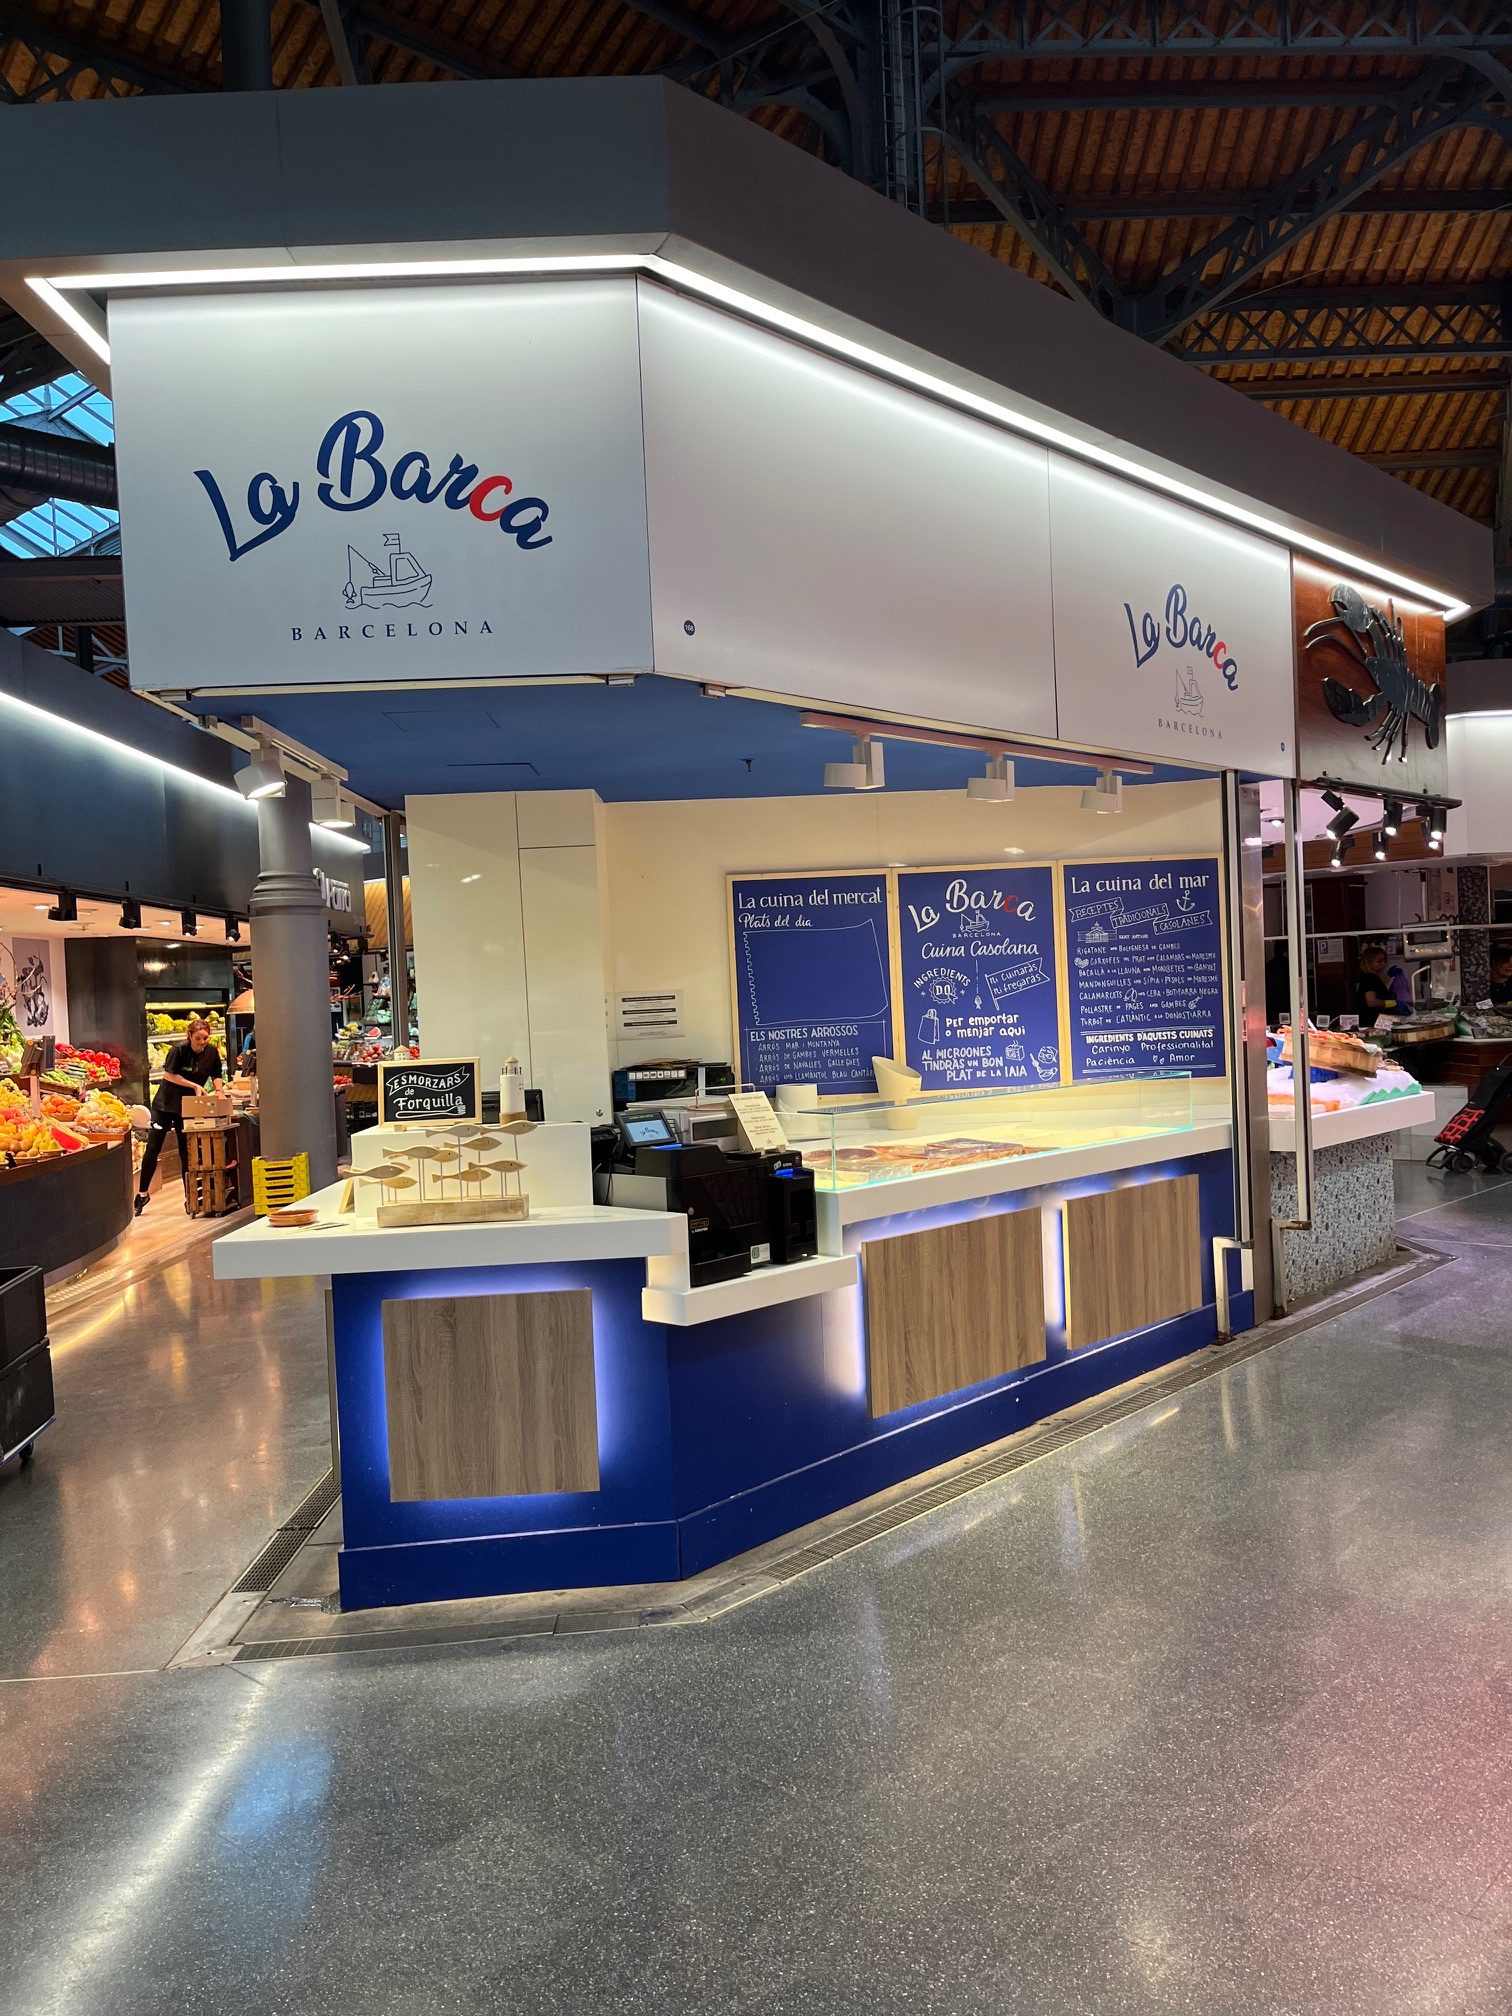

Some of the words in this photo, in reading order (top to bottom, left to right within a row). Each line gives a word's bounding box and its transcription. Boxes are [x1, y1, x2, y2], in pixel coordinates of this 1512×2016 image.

[194, 470, 299, 561] La
[317, 410, 552, 550] Barca
[292, 620, 493, 642] BARCELONA
[1124, 603, 1160, 668] La
[1165, 584, 1239, 691] Barca
[1158, 718, 1223, 740] BARCELONA
[1072, 877, 1090, 894] La
[1096, 877, 1141, 892] cuina
[1149, 873, 1172, 890] del
[1179, 874, 1209, 888] mar
[738, 893, 755, 909] La
[760, 893, 803, 907] cuina
[809, 889, 829, 905] del
[833, 887, 882, 905] mercat
[908, 904, 940, 933] La
[945, 879, 1036, 922] Barca
[1075, 900, 1119, 918] RECEPTES
[1113, 905, 1166, 926] TRADICIONALS
[738, 912, 770, 928] Plats
[775, 914, 789, 927] del
[1159, 914, 1206, 932] CASOLANES
[921, 942, 965, 960] Cuina
[970, 938, 1039, 957] Casolana
[1077, 946, 1106, 955] RIGATONE
[913, 967, 971, 988] INGREDIENTS
[968, 1012, 1019, 1026] emportar
[750, 1031, 766, 1042] ELS
[768, 1028, 808, 1040] NOSTRES
[811, 1025, 858, 1038] ARROSSOS
[1086, 1033, 1134, 1044] INGREDIENTS
[1179, 1029, 1213, 1039] CUINATS
[785, 1041, 799, 1050] MAR
[792, 1050, 816, 1059] GAMBES
[822, 1047, 859, 1057] VERMELLES
[922, 1050, 933, 1060] AL
[936, 1046, 992, 1059] MICROONES
[1092, 1044, 1131, 1054] Carinyo
[1141, 1040, 1214, 1052] Professionalitat
[794, 1061, 821, 1070] NAVALLES
[922, 1057, 965, 1072] TINDRÀS
[982, 1057, 1004, 1068] BON
[1086, 1057, 1135, 1067] Paciència
[1169, 1054, 1195, 1063] Amor
[394, 1073, 461, 1089] ESMORZARS
[832, 1070, 848, 1079] BLAU
[947, 1069, 973, 1082] PLAT
[1005, 1065, 1028, 1077] IAIA
[393, 1093, 463, 1110] Forquilla
